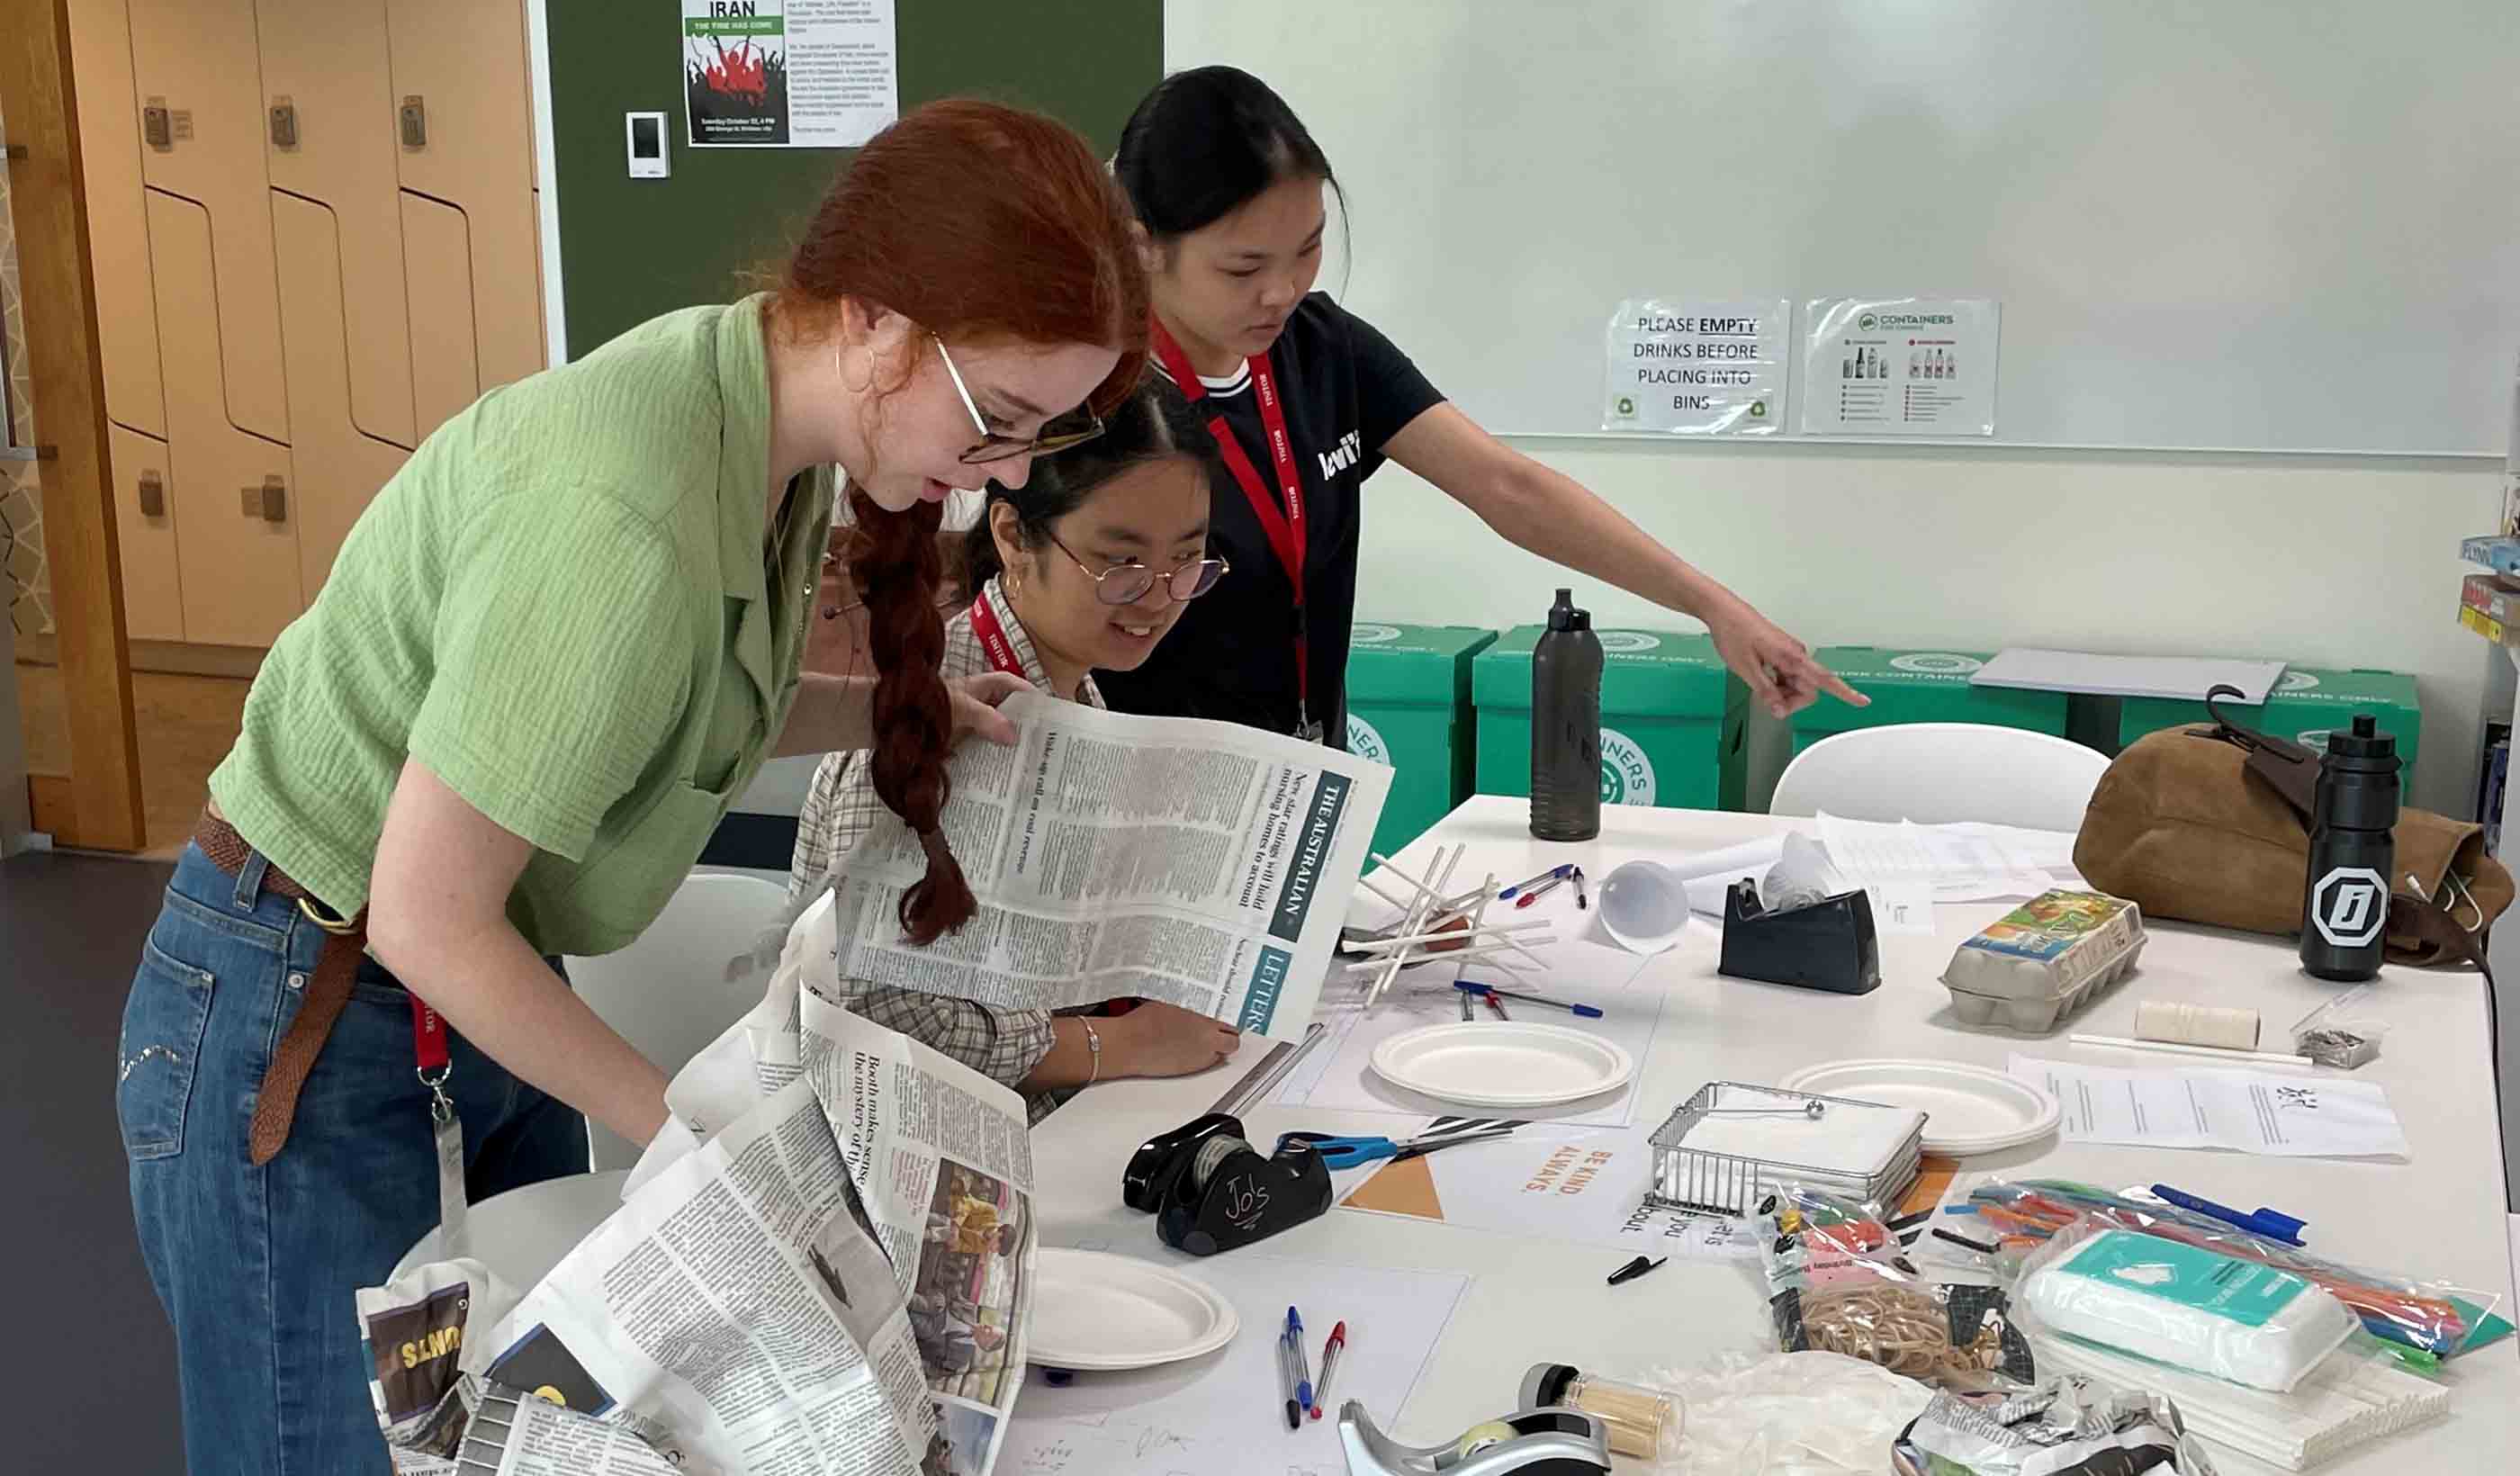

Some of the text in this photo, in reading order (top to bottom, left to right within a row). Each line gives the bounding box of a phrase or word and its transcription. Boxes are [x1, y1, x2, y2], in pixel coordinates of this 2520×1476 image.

[710, 1, 755, 17] IRAN
[1638, 318, 1758, 333] PLEASE EMPTY
[1880, 315, 1954, 325] CONTAINERS
[1634, 344, 1758, 359] DRINKS BEFORE
[1638, 370, 1751, 385] PLACING INTO
[1673, 395, 1711, 410] BINS
[1270, 768, 1292, 809] nursing
[1282, 797, 1297, 820] star
[1260, 812, 1280, 850] homes
[1270, 820, 1288, 859] ratings
[1254, 851, 1266, 863] to
[1284, 785, 1340, 915] THE AUSTRALIAN
[1262, 861, 1275, 884] will
[1238, 864, 1260, 908] account
[1252, 884, 1270, 911] hold
[1246, 954, 1284, 1030] LETTERS
[854, 1051, 866, 1075] the
[867, 1056, 881, 1097] Booth
[851, 1076, 865, 1128] mystery
[866, 1099, 879, 1144] makes
[851, 1133, 863, 1151] of
[856, 1146, 872, 1185] sense
[1585, 1150, 1614, 1166] BE
[1664, 1216, 1693, 1238] you
